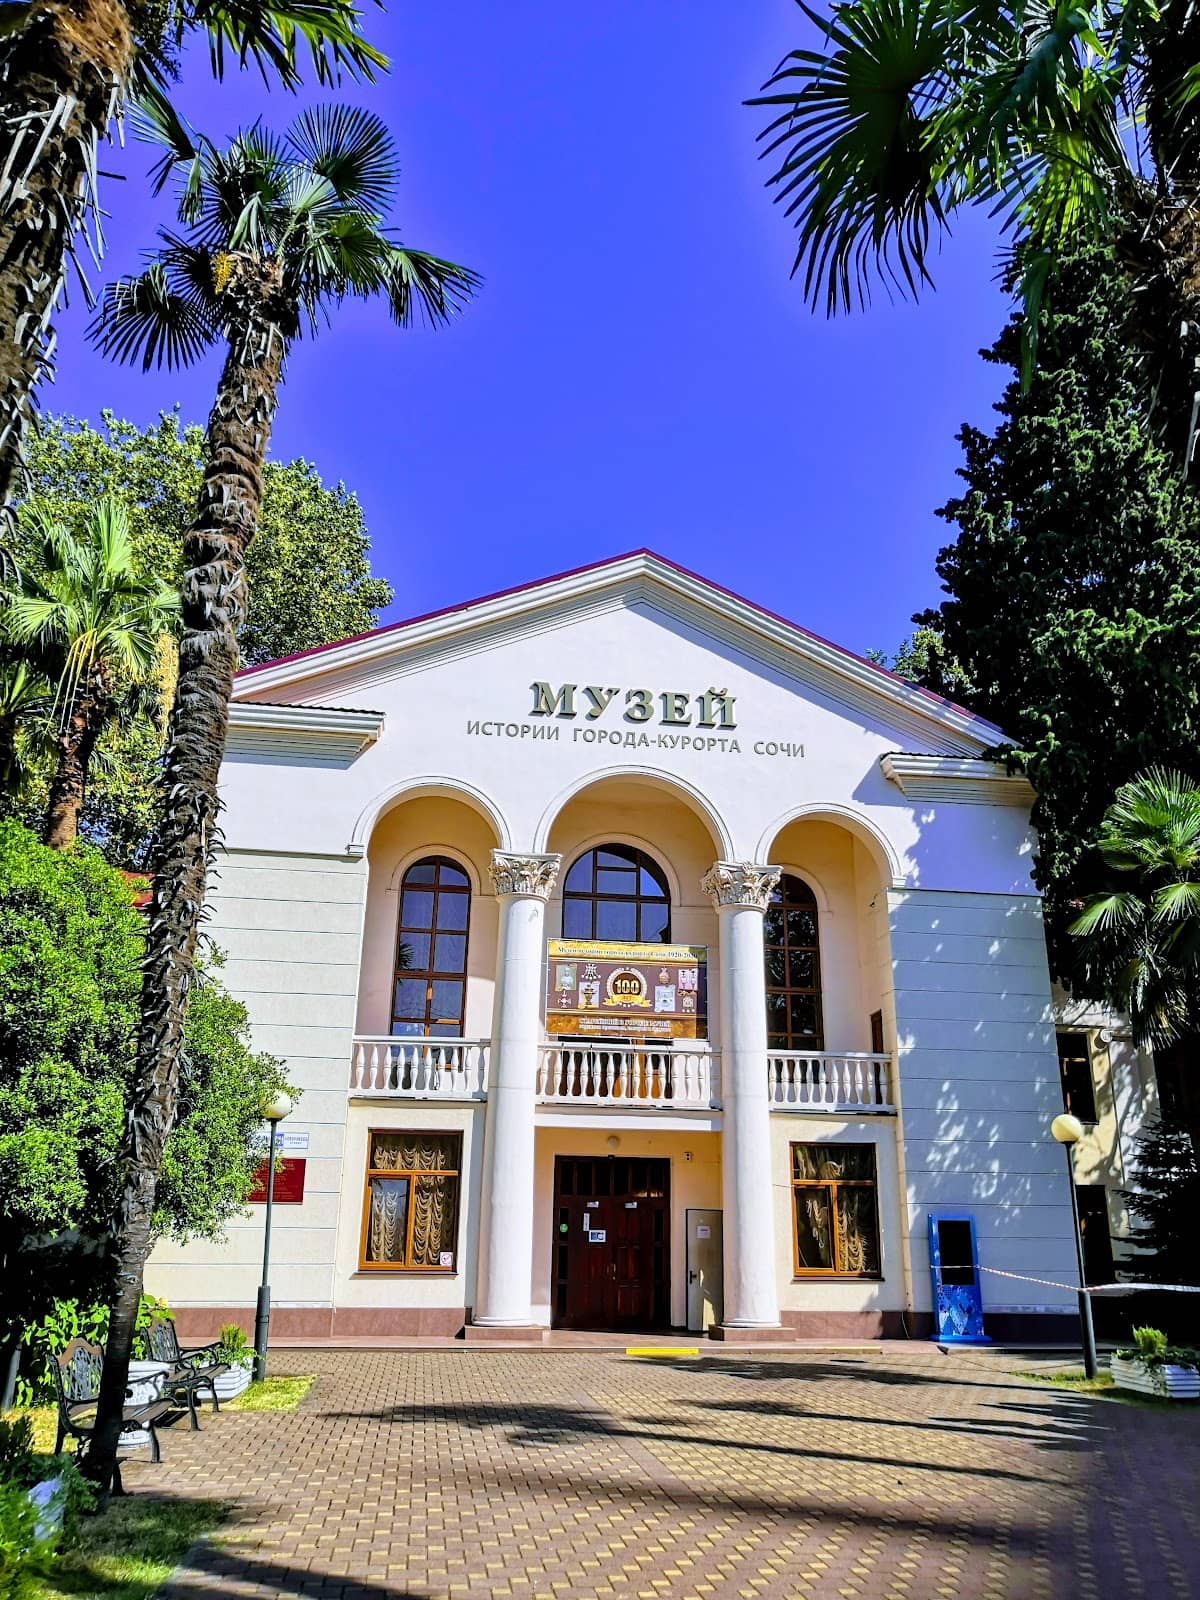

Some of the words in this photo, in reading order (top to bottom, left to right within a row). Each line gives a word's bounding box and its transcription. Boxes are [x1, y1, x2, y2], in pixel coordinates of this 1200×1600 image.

[528, 681, 738, 730] МУЗЕЙ
[466, 720, 560, 741] ИСТОРИИ
[573, 728, 741, 754] ГОРОДА-КУРОРТА
[753, 742, 805, 759] СОЧИ
[614, 979, 640, 994] 100
